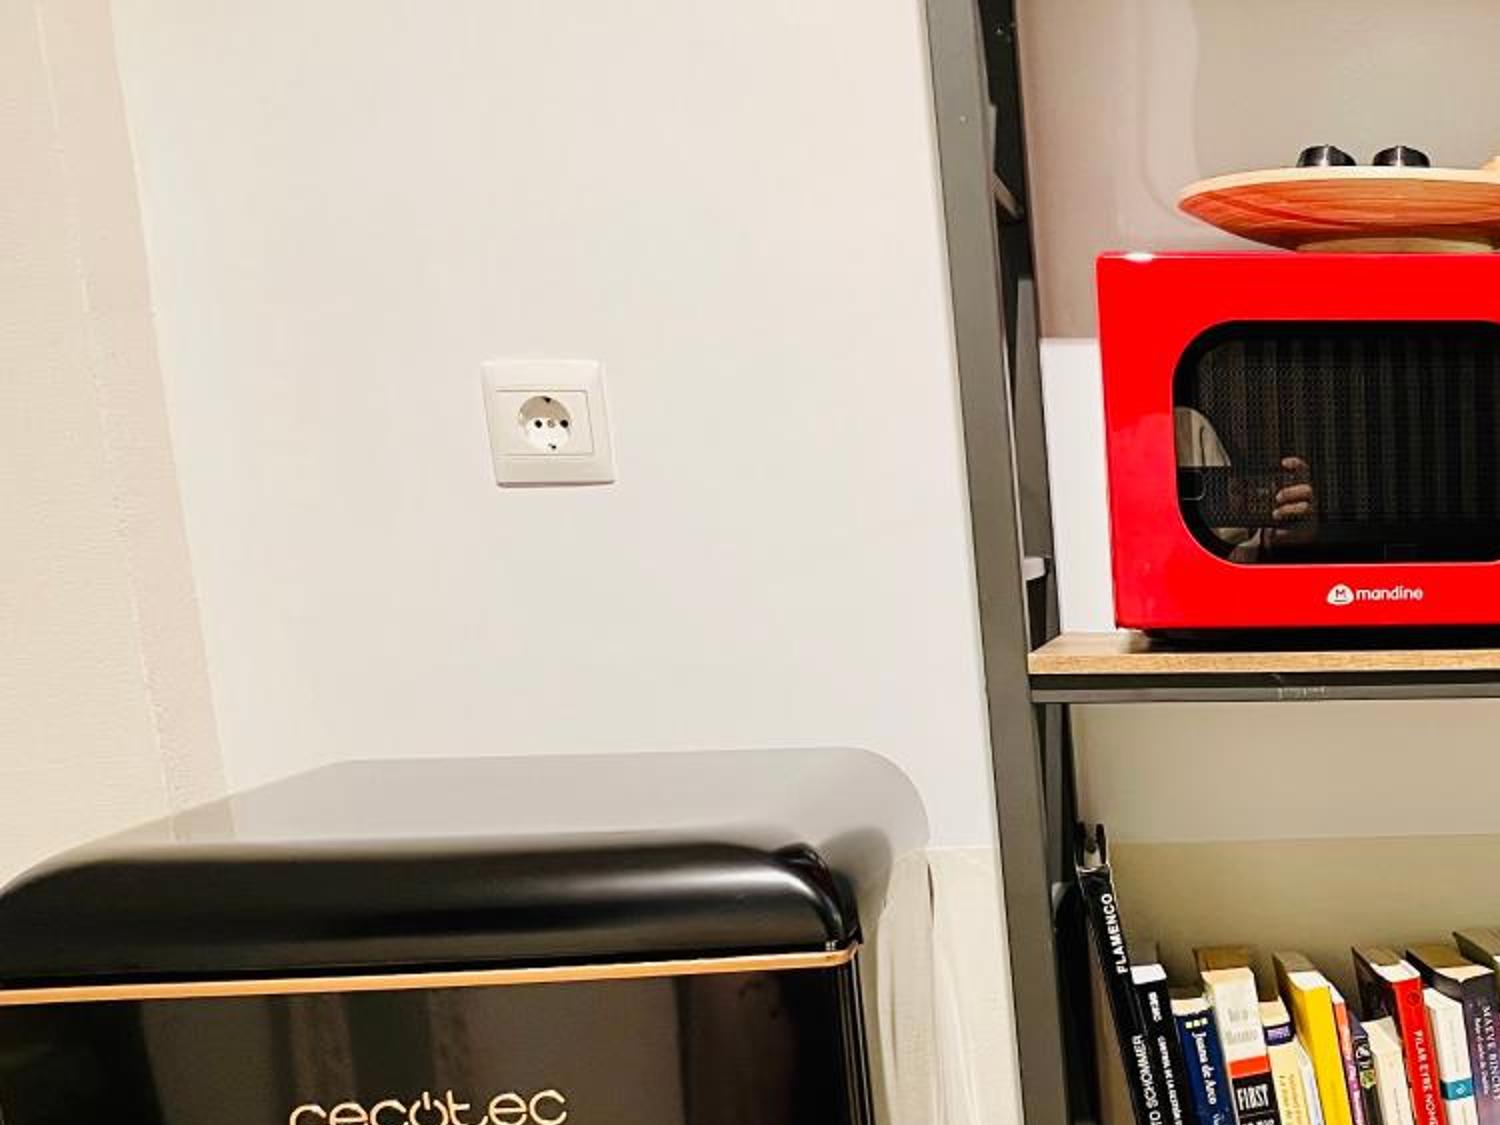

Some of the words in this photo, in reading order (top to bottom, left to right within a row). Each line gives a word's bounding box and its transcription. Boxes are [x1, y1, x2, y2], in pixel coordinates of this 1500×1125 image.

[1355, 584, 1424, 601] mandine
[1101, 892, 1128, 975] FLAMENCO
[1482, 1006, 1496, 1050] MAEVE
[1192, 1031, 1208, 1064] Juana
[1132, 1035, 1158, 1108] SCHOMMER
[1201, 1063, 1213, 1079] de
[1204, 1079, 1217, 1105] Arco
[1237, 1084, 1269, 1111] FIRST
